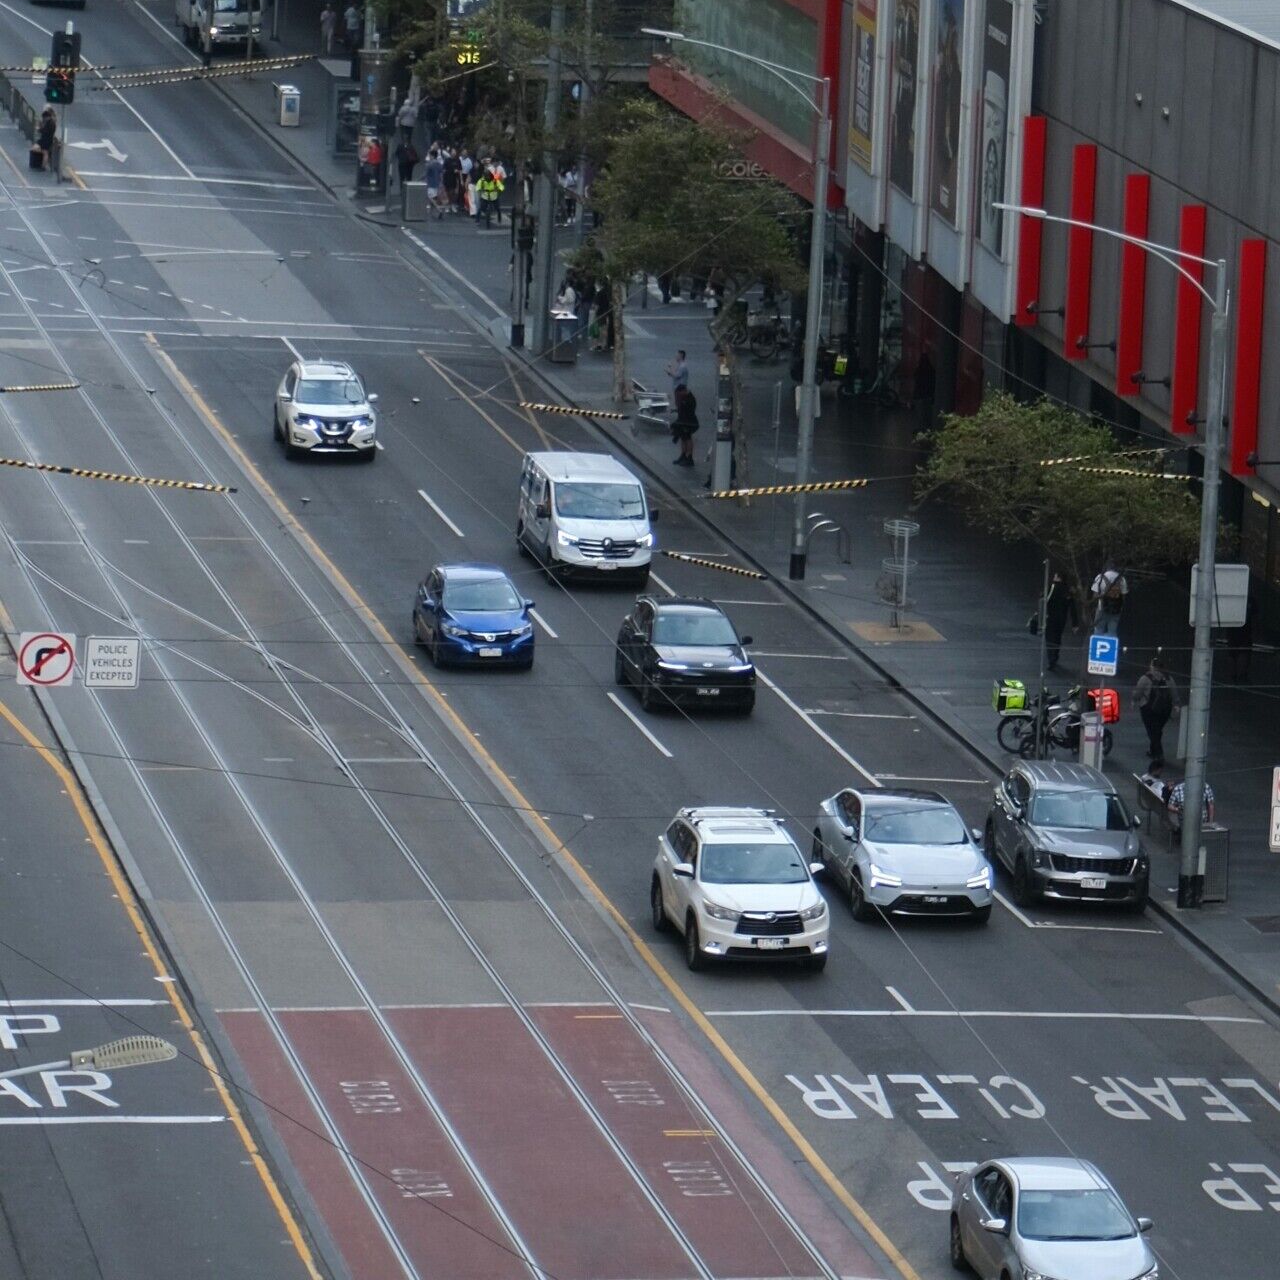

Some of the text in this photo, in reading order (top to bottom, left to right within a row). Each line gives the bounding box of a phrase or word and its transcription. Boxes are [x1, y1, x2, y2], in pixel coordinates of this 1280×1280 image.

[719, 160, 769, 177] cole
[98, 645, 128, 654] POLICE
[1096, 641, 1111, 659] P
[92, 658, 133, 668] VEHICLES
[90, 671, 133, 681] EXCEPTED
[784, 1074, 1046, 1120] CLEAR
